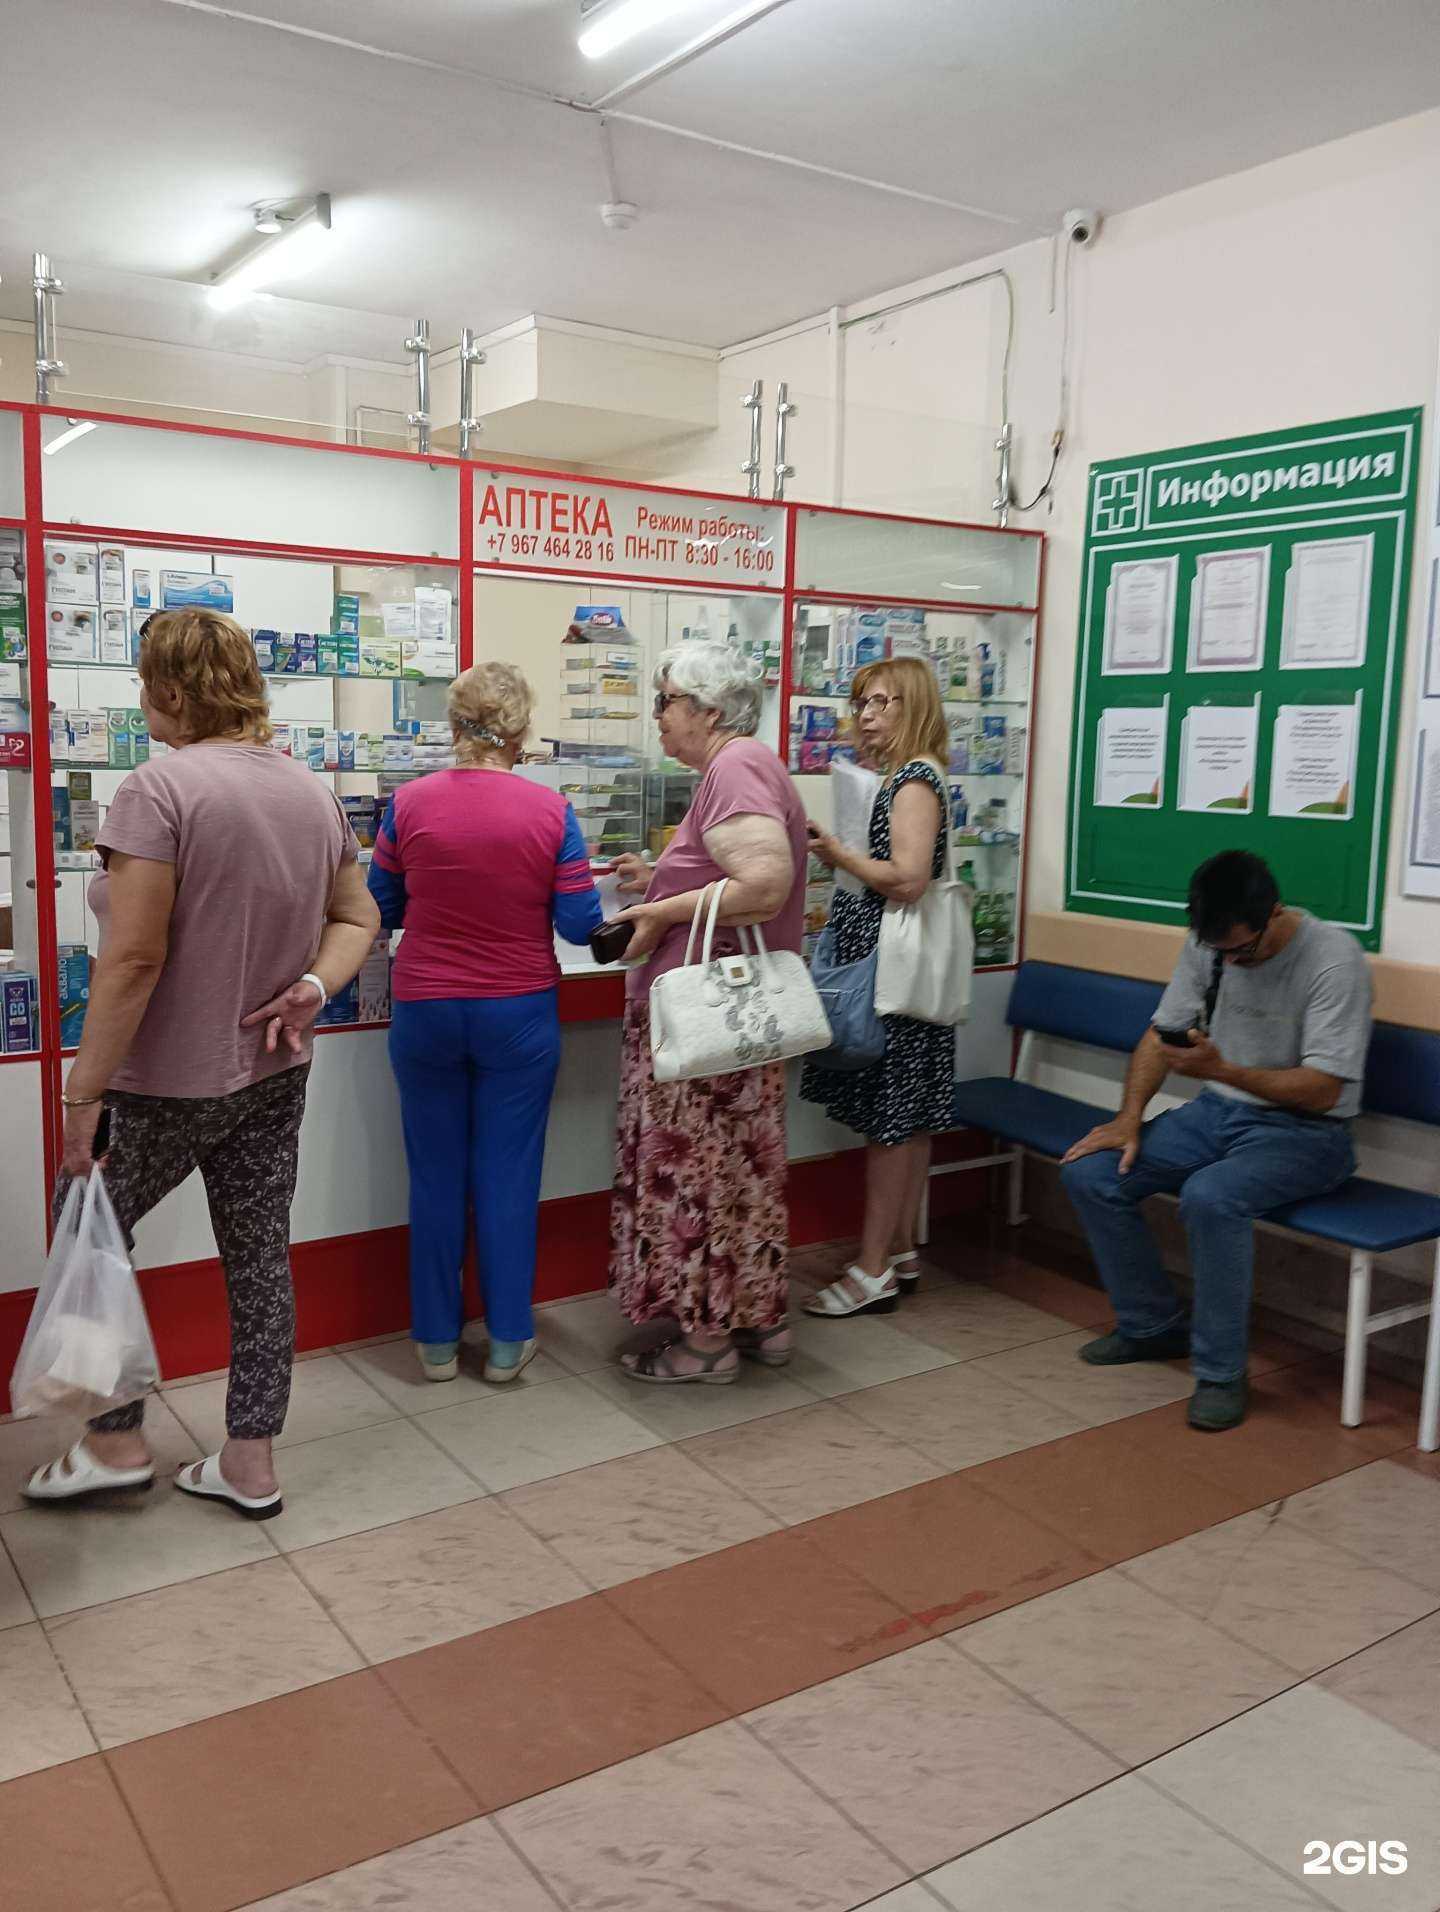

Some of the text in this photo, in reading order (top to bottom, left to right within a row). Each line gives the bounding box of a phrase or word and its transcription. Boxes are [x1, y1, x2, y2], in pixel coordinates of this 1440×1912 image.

[1157, 450, 1397, 508] Информация
[478, 484, 613, 538] АПТЕКА
[637, 506, 765, 540] Режим работы:
[487, 533, 614, 562] +7 967 464 28 16
[625, 535, 678, 562] ПН-ПТ
[685, 542, 719, 566] 8:30
[734, 547, 774, 571] 16:00
